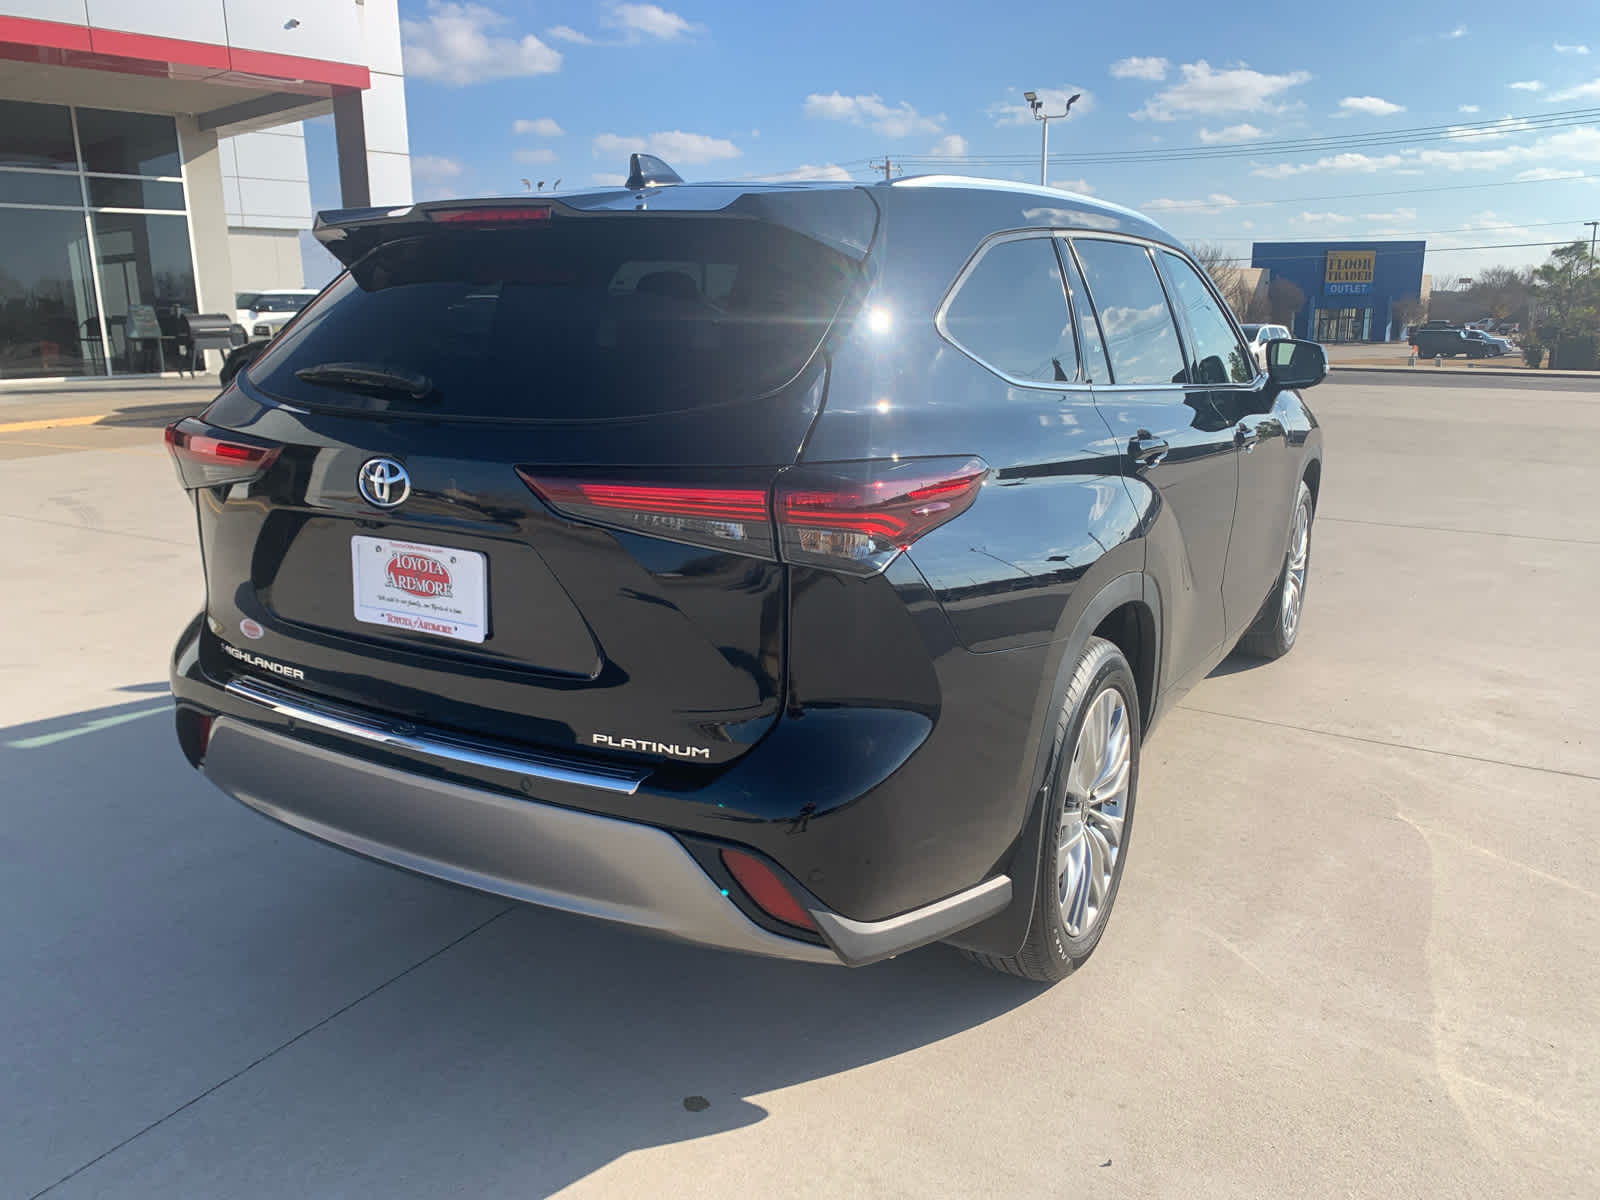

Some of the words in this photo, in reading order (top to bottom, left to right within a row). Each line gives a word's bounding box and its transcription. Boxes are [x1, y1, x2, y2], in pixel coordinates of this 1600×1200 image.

[1328, 258, 1372, 270] FLOOR
[1327, 271, 1372, 281] TRADER
[1330, 284, 1368, 293] OUTLET
[392, 552, 444, 575] TOYOTA
[385, 571, 453, 598] ARDMORE
[592, 733, 710, 759] PLATINUM
